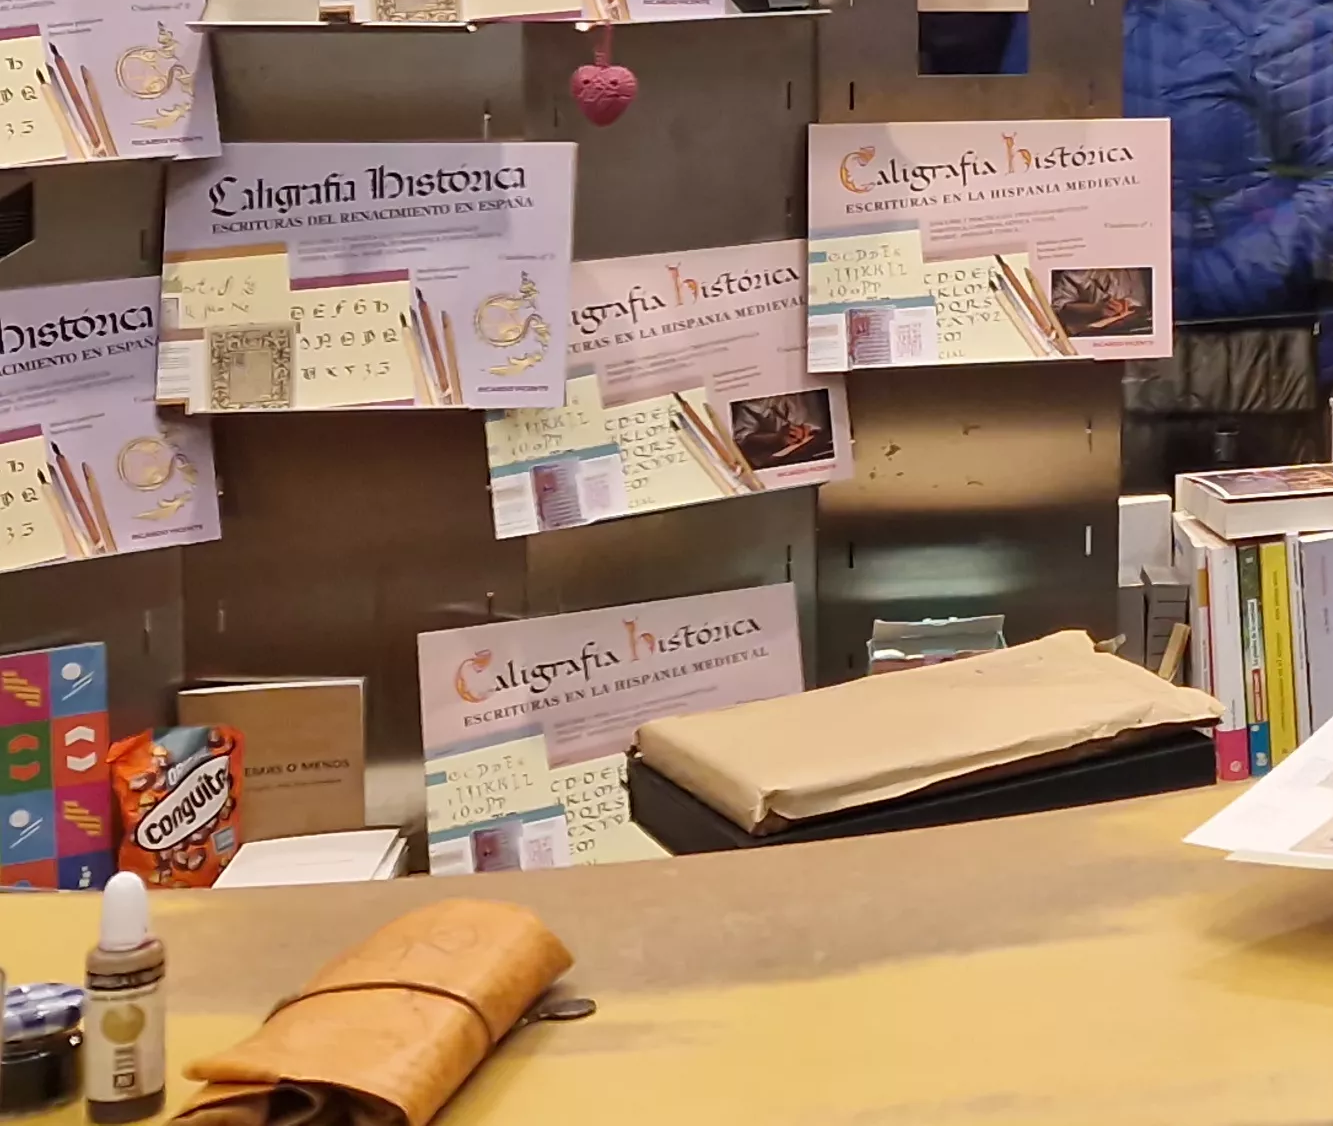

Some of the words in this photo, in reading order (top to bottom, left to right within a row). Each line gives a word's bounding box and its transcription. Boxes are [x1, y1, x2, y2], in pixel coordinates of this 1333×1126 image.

[367, 164, 526, 202] Histórica
[839, 145, 997, 194] Caligrafía
[845, 195, 937, 215] ESCRITURAS
[943, 192, 962, 205] EN
[968, 189, 985, 202] LA
[990, 182, 1061, 201] HISPANIA
[1066, 175, 1140, 192] MEDIEVAL
[212, 217, 303, 235] ESCRITURAS
[308, 214, 337, 228] DEL
[340, 204, 450, 224] RENACIMIENTO
[455, 202, 474, 215] EN
[479, 197, 534, 213] ESPAÑA
[615, 330, 634, 345] EN
[639, 327, 657, 340] LA
[660, 311, 732, 334] HISPANIA
[82, 346, 102, 361] EN
[464, 693, 560, 727] ESCRITURAS
[565, 688, 586, 705] EN
[590, 683, 610, 698] LA
[614, 665, 689, 693] HISPANIA
[693, 647, 769, 674] MEDIEVAL
